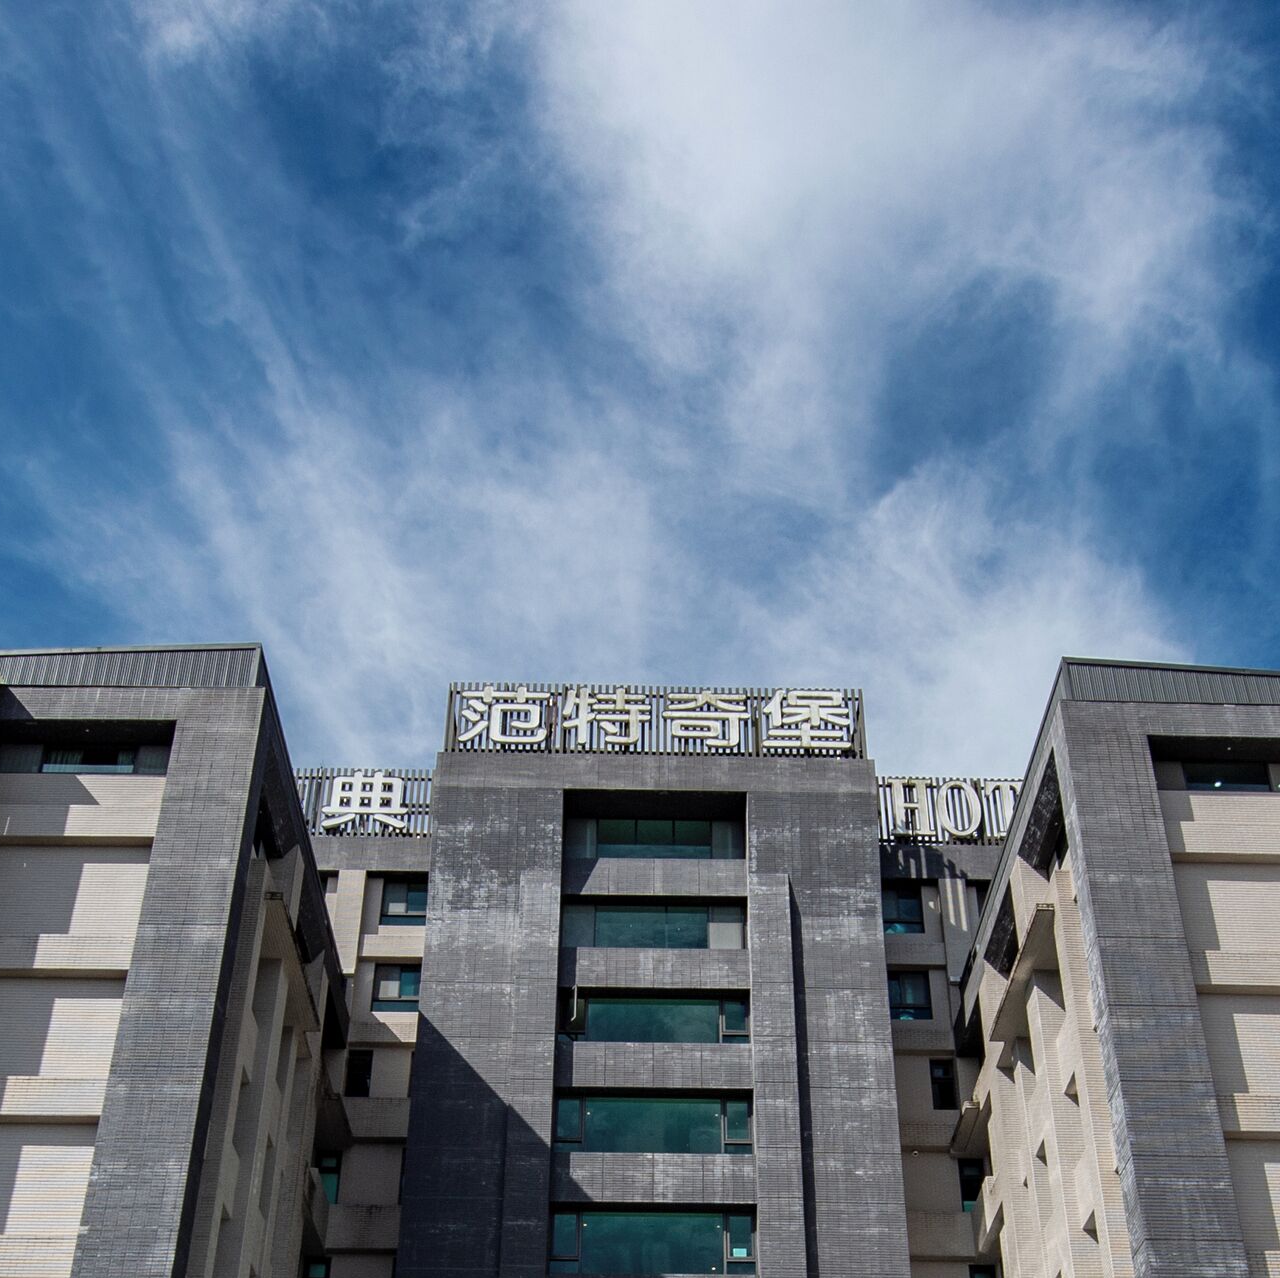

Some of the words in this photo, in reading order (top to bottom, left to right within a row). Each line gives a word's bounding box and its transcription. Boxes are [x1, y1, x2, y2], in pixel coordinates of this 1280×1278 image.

[457, 685, 852, 749] 范特奇堡
[321, 769, 409, 829] 典
